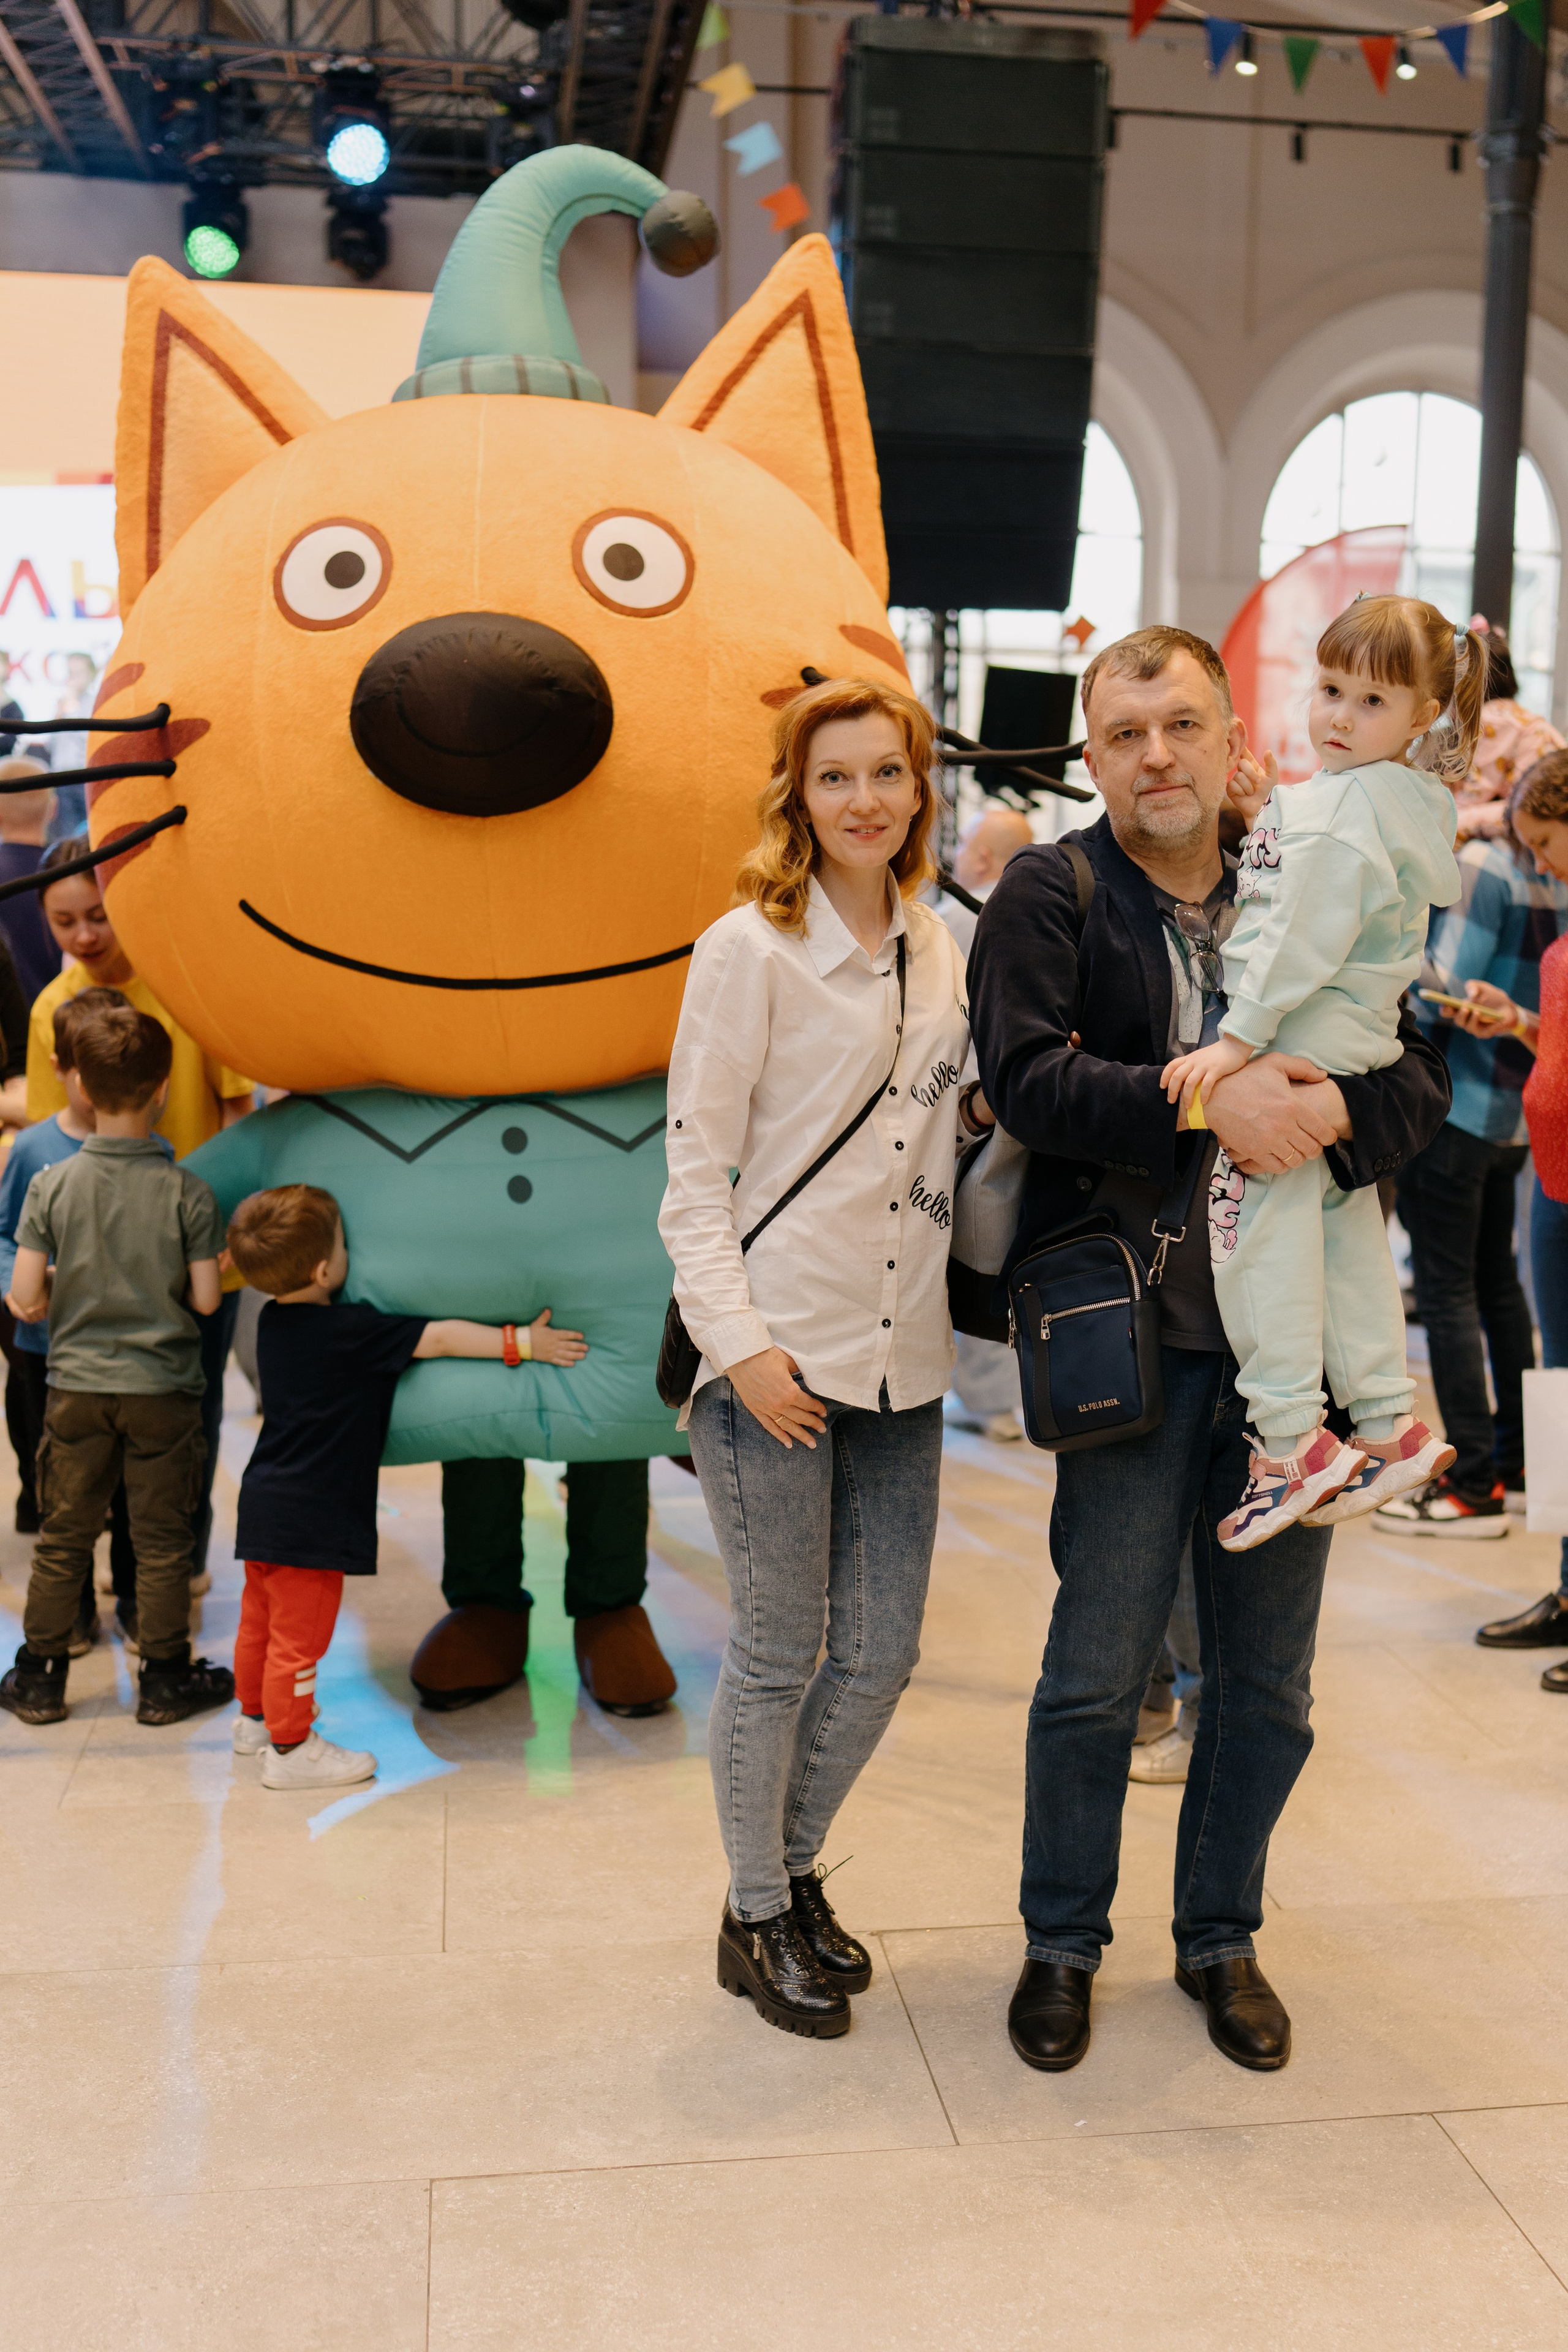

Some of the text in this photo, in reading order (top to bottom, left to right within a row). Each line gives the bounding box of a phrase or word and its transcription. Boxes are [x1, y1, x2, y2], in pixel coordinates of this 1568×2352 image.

[911, 1061, 959, 1107] hello
[909, 1175, 951, 1230] hello
[1078, 1398, 1120, 1412] U.S. POLO ASSN.
